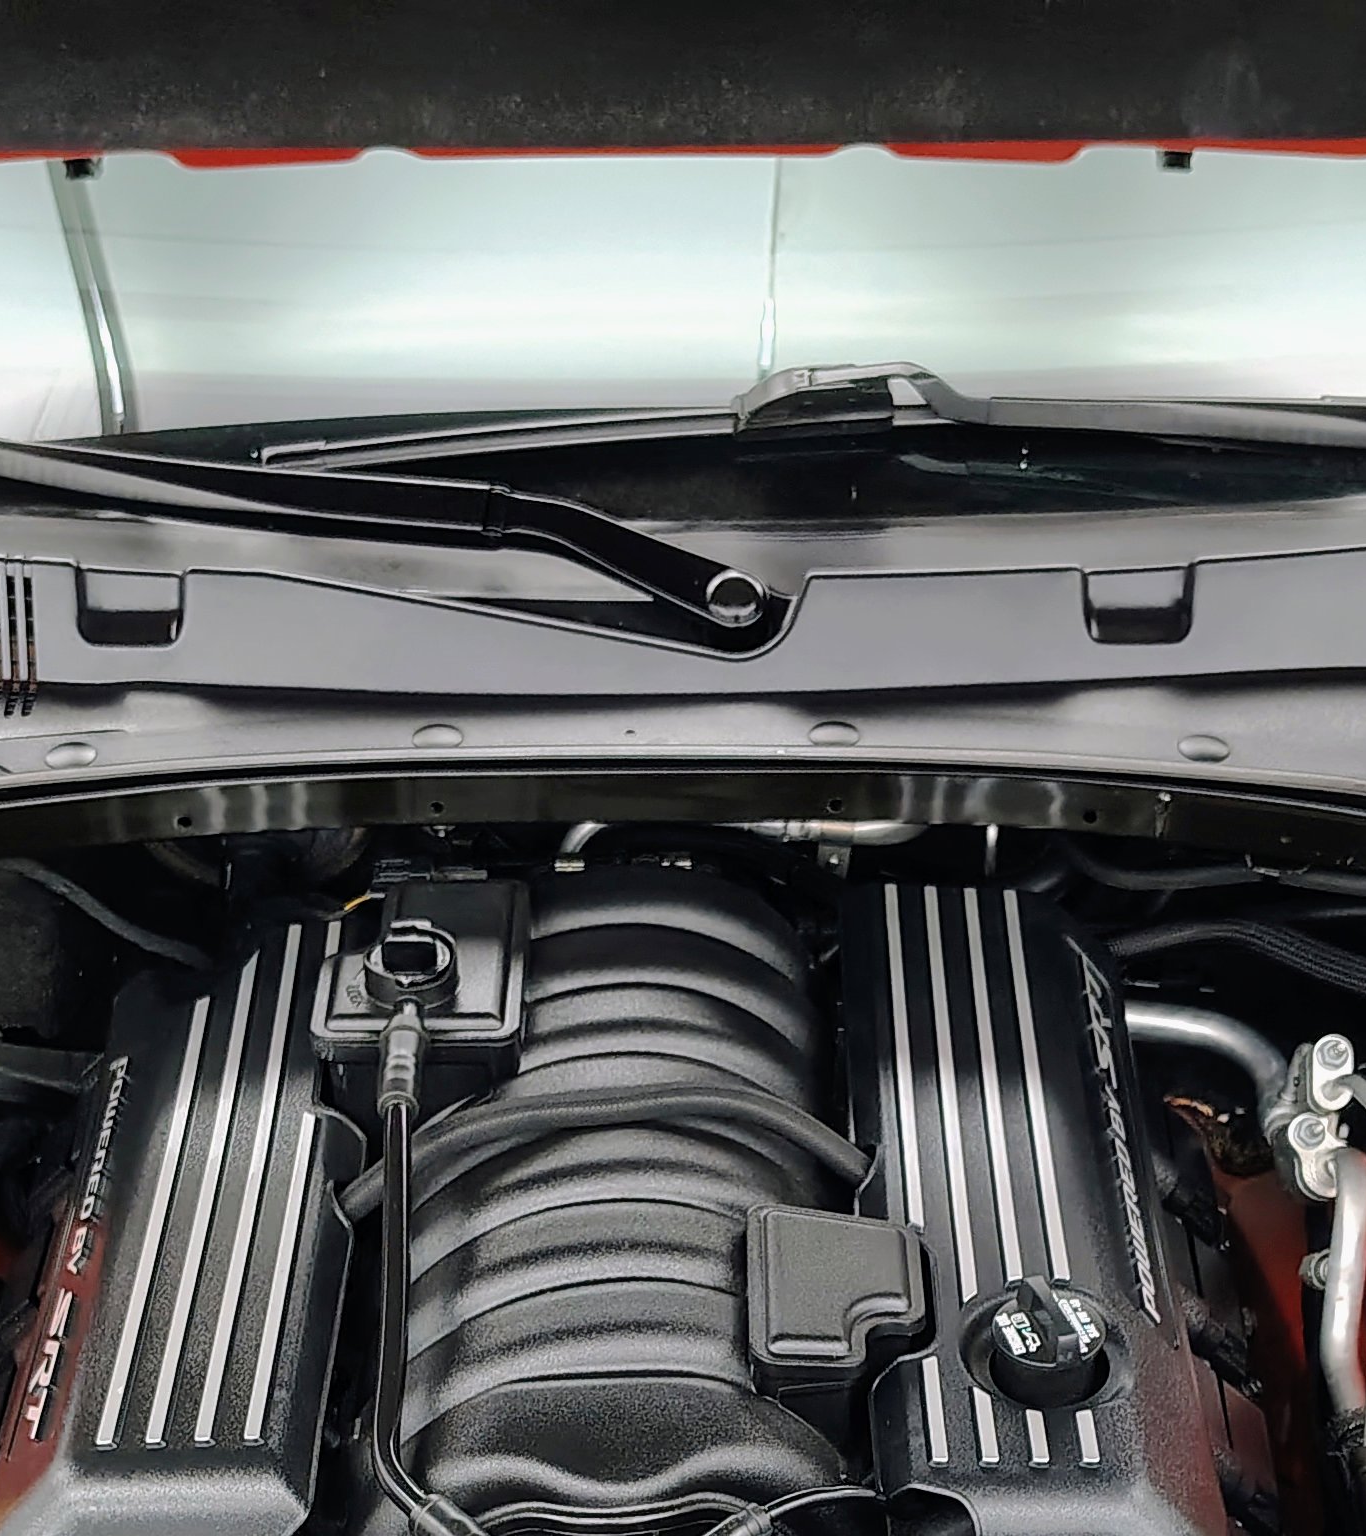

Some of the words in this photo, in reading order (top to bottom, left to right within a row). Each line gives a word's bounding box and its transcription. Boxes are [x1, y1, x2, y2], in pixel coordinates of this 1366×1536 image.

[79, 1055, 129, 1222] POWERED
[65, 1225, 89, 1275] BY
[1114, 1137, 1161, 1324] POWERED
[24, 1287, 73, 1441] SRT
